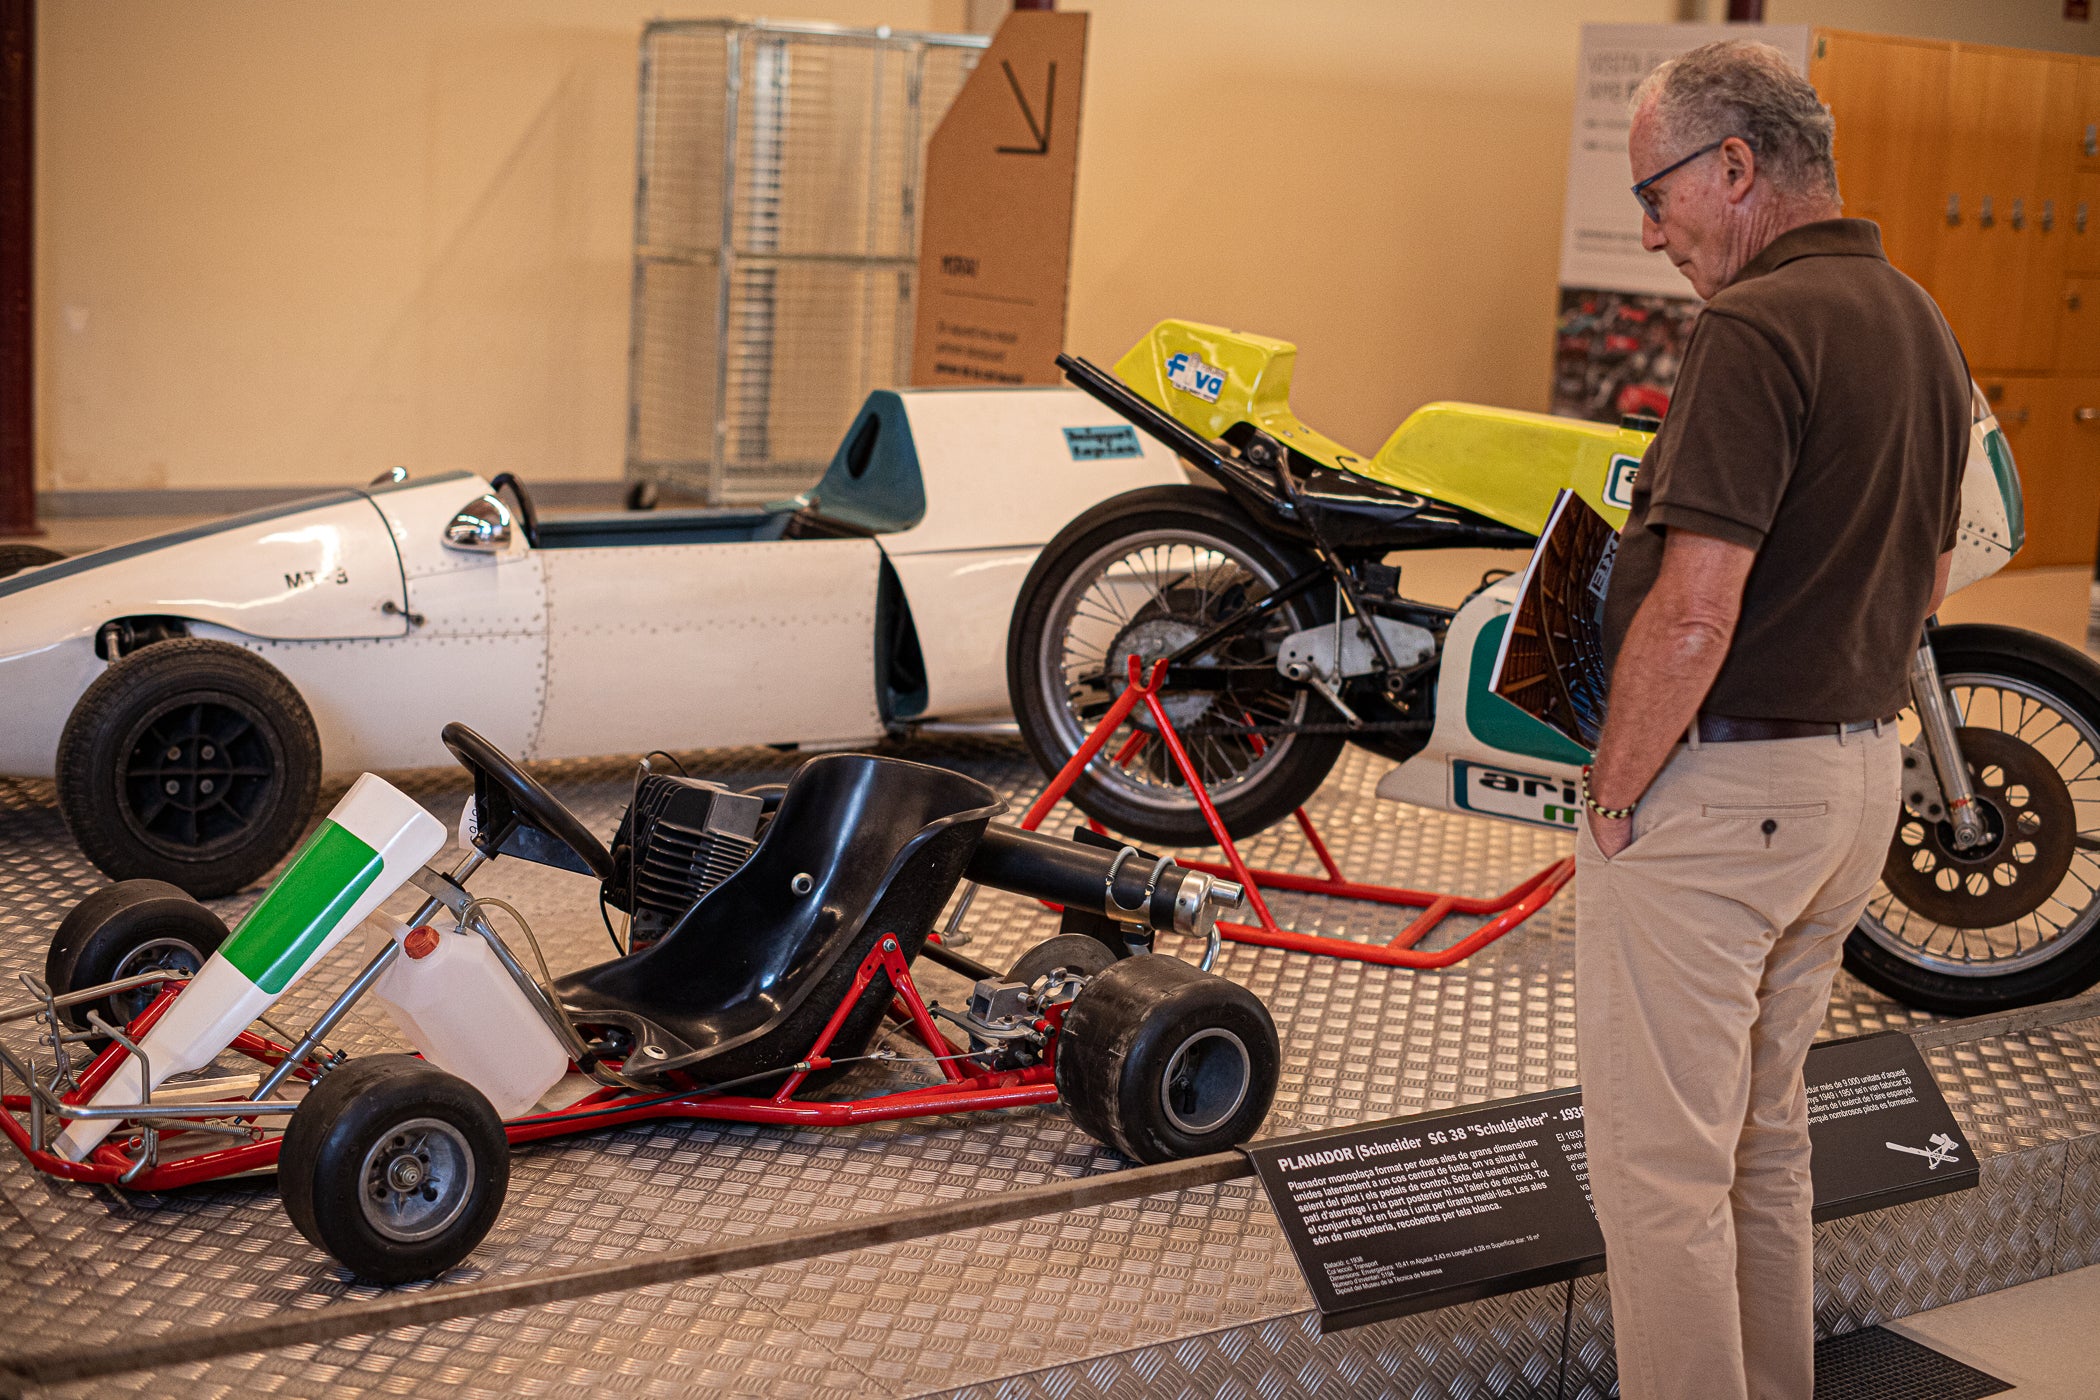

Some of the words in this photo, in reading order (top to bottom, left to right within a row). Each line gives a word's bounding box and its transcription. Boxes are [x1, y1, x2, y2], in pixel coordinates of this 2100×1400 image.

[1278, 1148, 1354, 1172] PLANADOR
[1355, 1137, 1421, 1161] (Schneider
[1428, 1131, 1448, 1145] SG
[1448, 1128, 1467, 1141] 38
[1467, 1112, 1548, 1136] "Schulgleiter"
[1287, 1178, 1326, 1191] Planador
[1328, 1169, 1375, 1183] monoplaça
[1374, 1163, 1403, 1175] format
[1403, 1162, 1417, 1172] per
[1419, 1158, 1439, 1167] dues
[1440, 1154, 1457, 1163] ales
[1458, 1151, 1469, 1160] de
[1469, 1148, 1493, 1159] grans
[1493, 1139, 1538, 1153] dimensions
[1293, 1190, 1323, 1202] unides
[1323, 1180, 1371, 1196] lateralment
[1378, 1178, 1391, 1186] un
[1391, 1175, 1407, 1183] cos
[1408, 1168, 1436, 1180] central
[1437, 1167, 1448, 1175] de
[1448, 1163, 1472, 1172] fusta,
[1495, 1153, 1518, 1164] situat
[1518, 1151, 1526, 1159] el
[1298, 1200, 1325, 1213] seient
[1326, 1197, 1340, 1207] del
[1340, 1194, 1360, 1206] pilot
[1365, 1191, 1379, 1200] els
[1379, 1185, 1407, 1199] pedals
[1408, 1183, 1419, 1192] de
[1420, 1177, 1452, 1189] control.
[1451, 1174, 1471, 1183] Sota
[1472, 1170, 1485, 1179] del
[1485, 1166, 1510, 1177] seient
[1509, 1163, 1519, 1172] hi
[1530, 1160, 1539, 1168] el
[1321, 1206, 1366, 1220] d'aterratge
[1378, 1201, 1388, 1209] la
[1388, 1197, 1406, 1209] part
[1406, 1191, 1442, 1205] posterior
[1443, 1187, 1453, 1196] hi
[1490, 1179, 1501, 1187] de
[1535, 1169, 1549, 1178] Tot
[1308, 1225, 1317, 1234] el
[1318, 1219, 1351, 1232] conjunt
[1362, 1214, 1375, 1223] fet
[1376, 1213, 1387, 1221] en
[1387, 1209, 1410, 1219] fusta
[1414, 1203, 1432, 1214] unit
[1432, 1202, 1445, 1212] per
[1446, 1196, 1473, 1207] tirants
[1514, 1186, 1530, 1194] Les
[1530, 1182, 1547, 1191] ales
[1313, 1235, 1330, 1245] són
[1331, 1233, 1342, 1242] de
[1343, 1223, 1397, 1239] marqueteria,
[1397, 1214, 1441, 1228] recobertes
[1441, 1211, 1455, 1222] per
[1456, 1207, 1472, 1217] tela
[1471, 1203, 1502, 1214] blanca.
[1353, 1261, 1378, 1269] Transport
